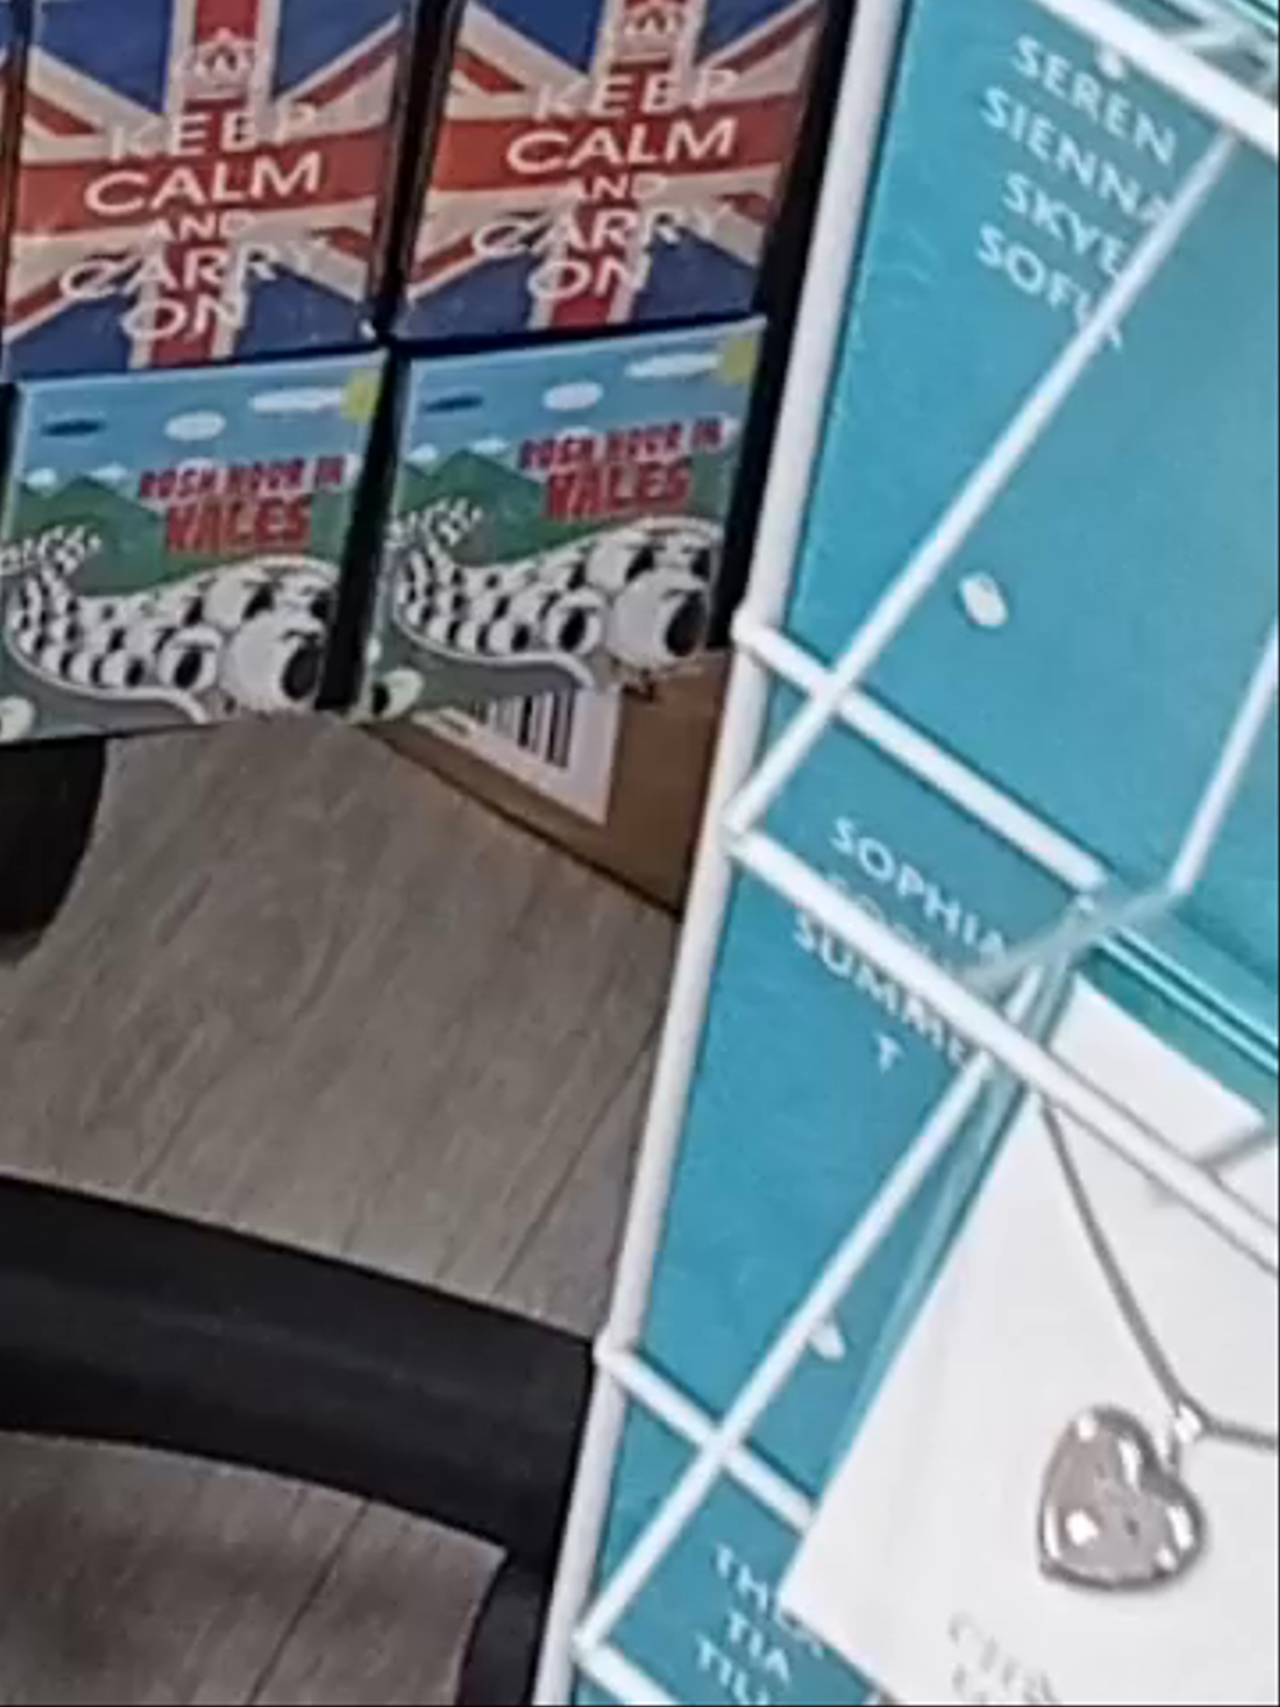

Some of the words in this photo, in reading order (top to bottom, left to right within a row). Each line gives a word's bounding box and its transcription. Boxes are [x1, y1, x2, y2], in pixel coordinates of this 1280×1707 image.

[537, 69, 740, 121] KEEP
[1010, 35, 1178, 166] SEREN
[110, 105, 318, 162] KEEP
[508, 118, 739, 175] CALM
[84, 150, 322, 216] CALM
[571, 170, 668, 202] AND
[145, 213, 255, 241] AND
[472, 200, 735, 259] CARRY
[1001, 172, 1131, 280] SKYE
[59, 236, 334, 303] CARRY
[528, 251, 650, 301] ON
[120, 295, 249, 342] ON
